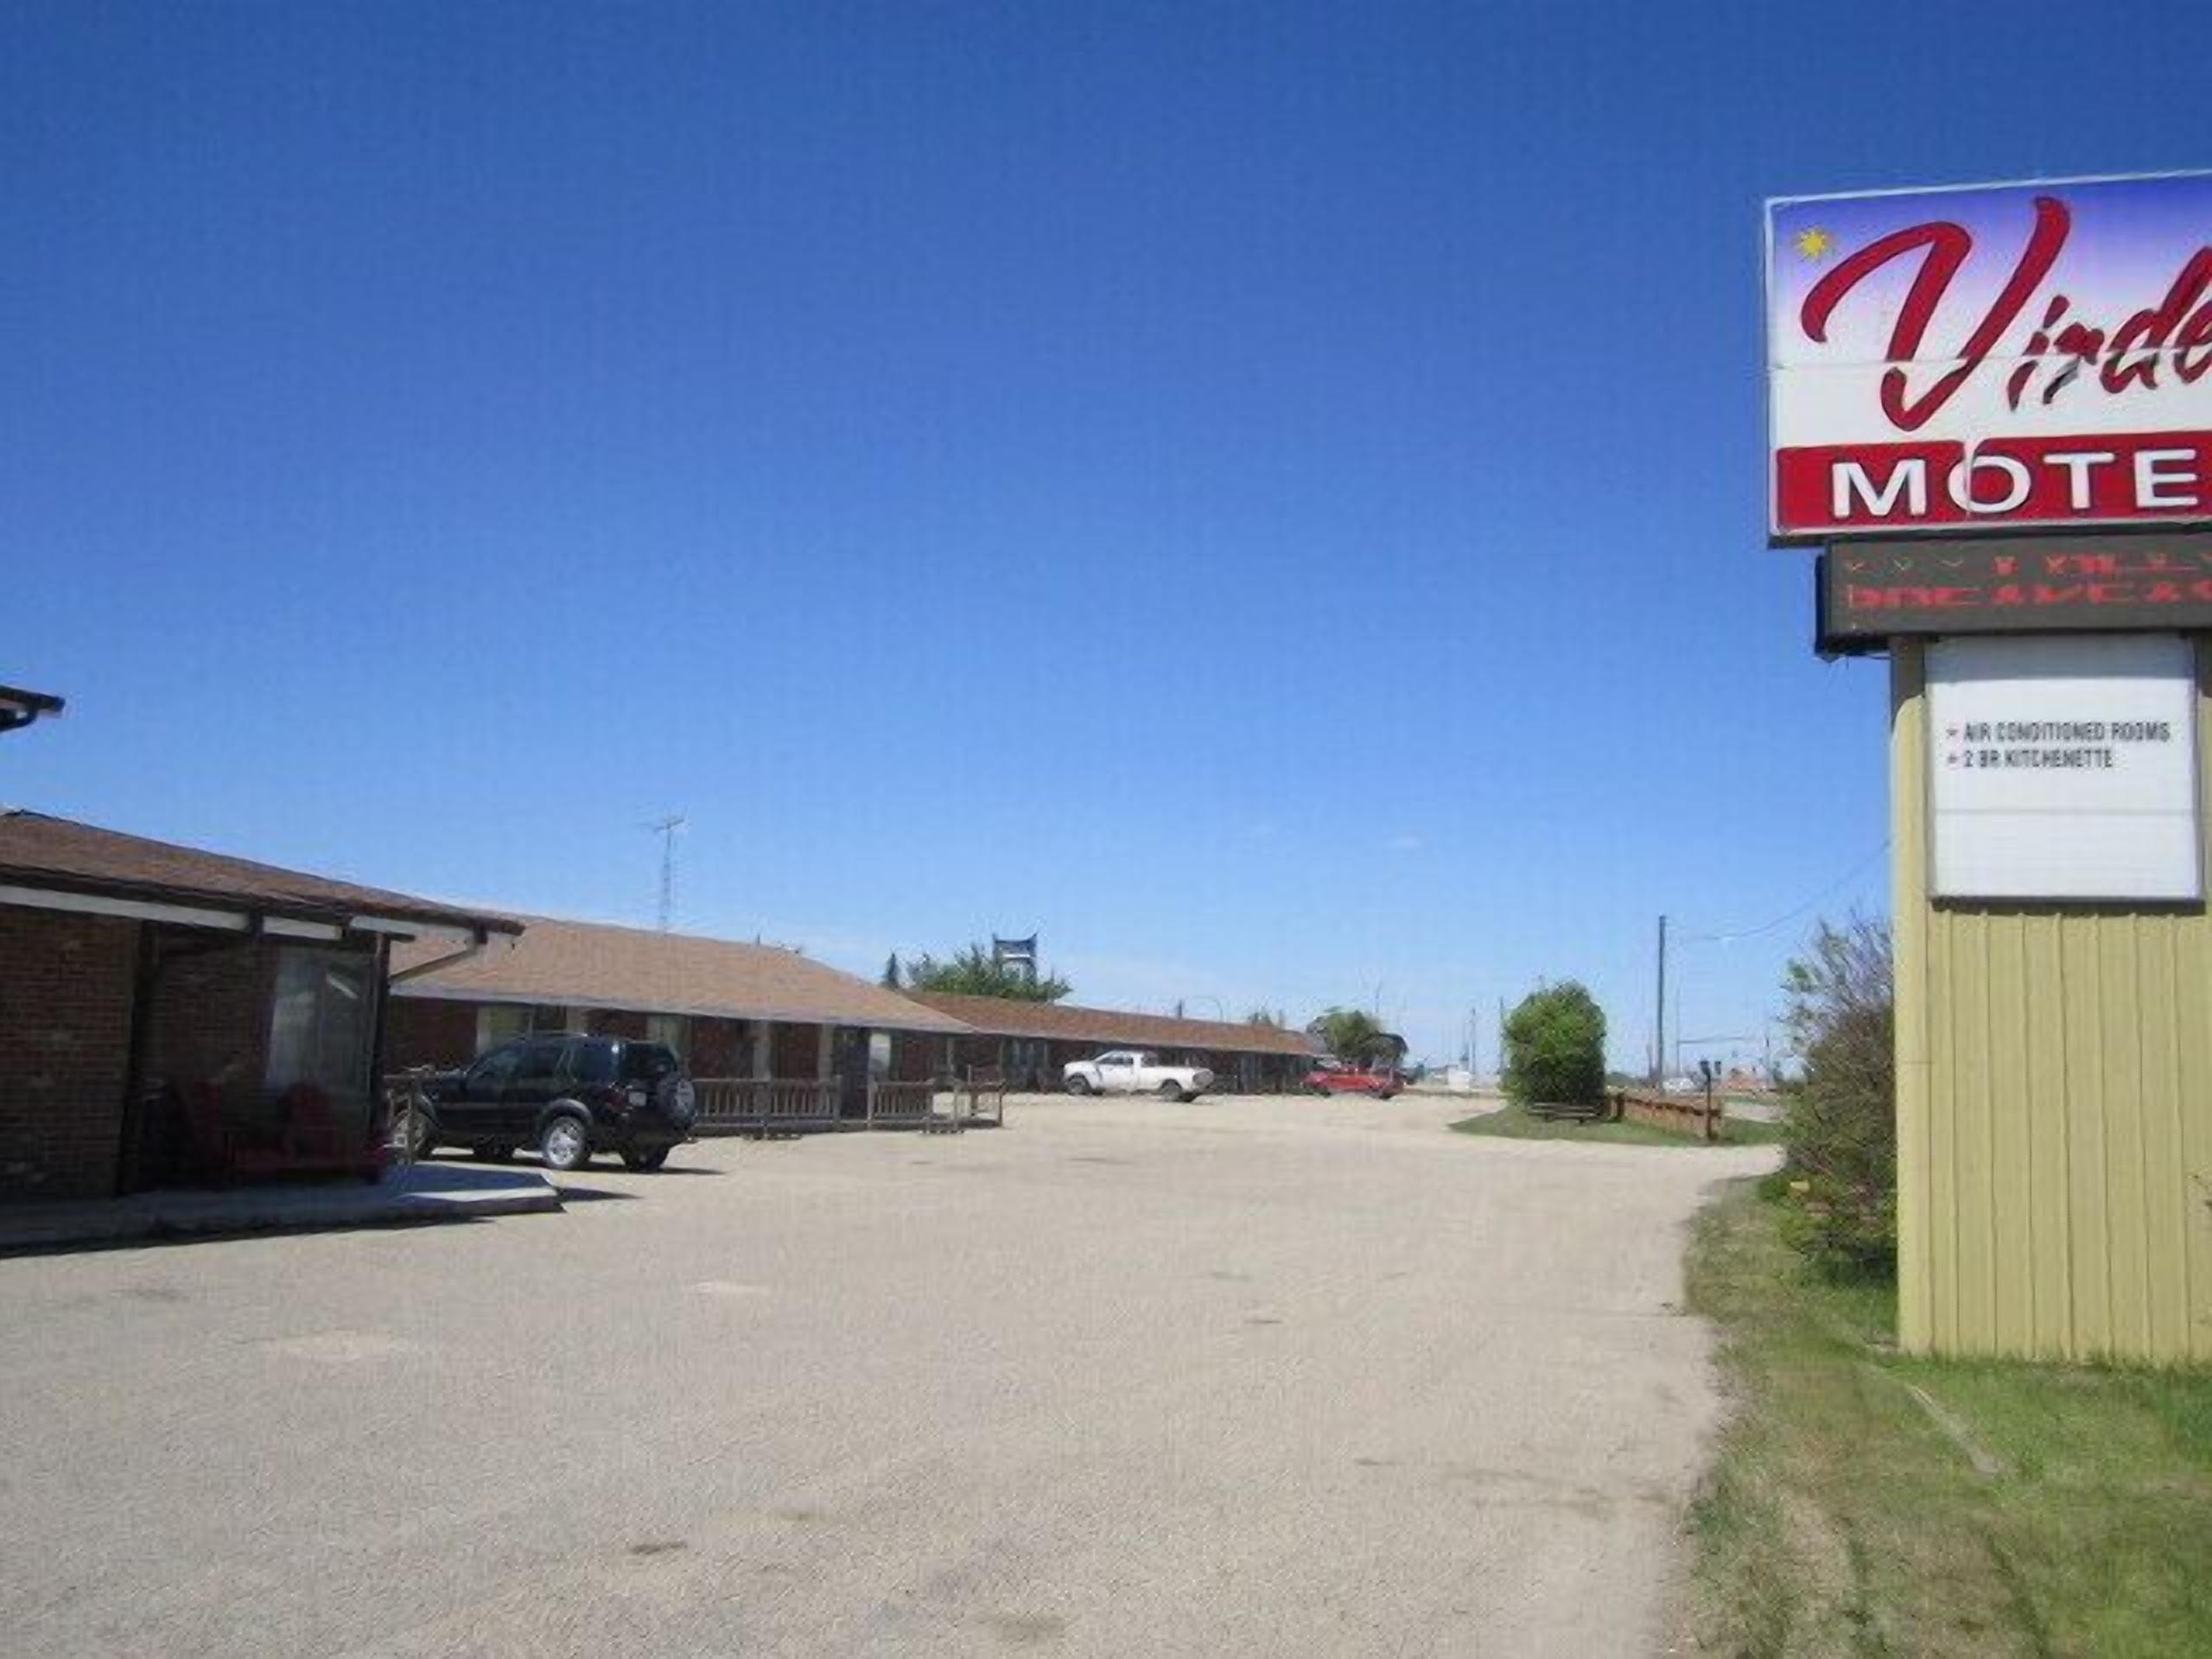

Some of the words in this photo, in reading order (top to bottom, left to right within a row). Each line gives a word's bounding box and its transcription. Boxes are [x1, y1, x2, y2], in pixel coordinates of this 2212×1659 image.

[1831, 448, 2200, 519] MOTE
[1964, 721, 1991, 742] AIR
[1996, 721, 2106, 741] CONDITIONED
[2111, 721, 2171, 742] ROOMS
[1963, 749, 1974, 767] 2
[1979, 749, 2001, 767] BR
[2005, 748, 2113, 768] KITCHENETTE
